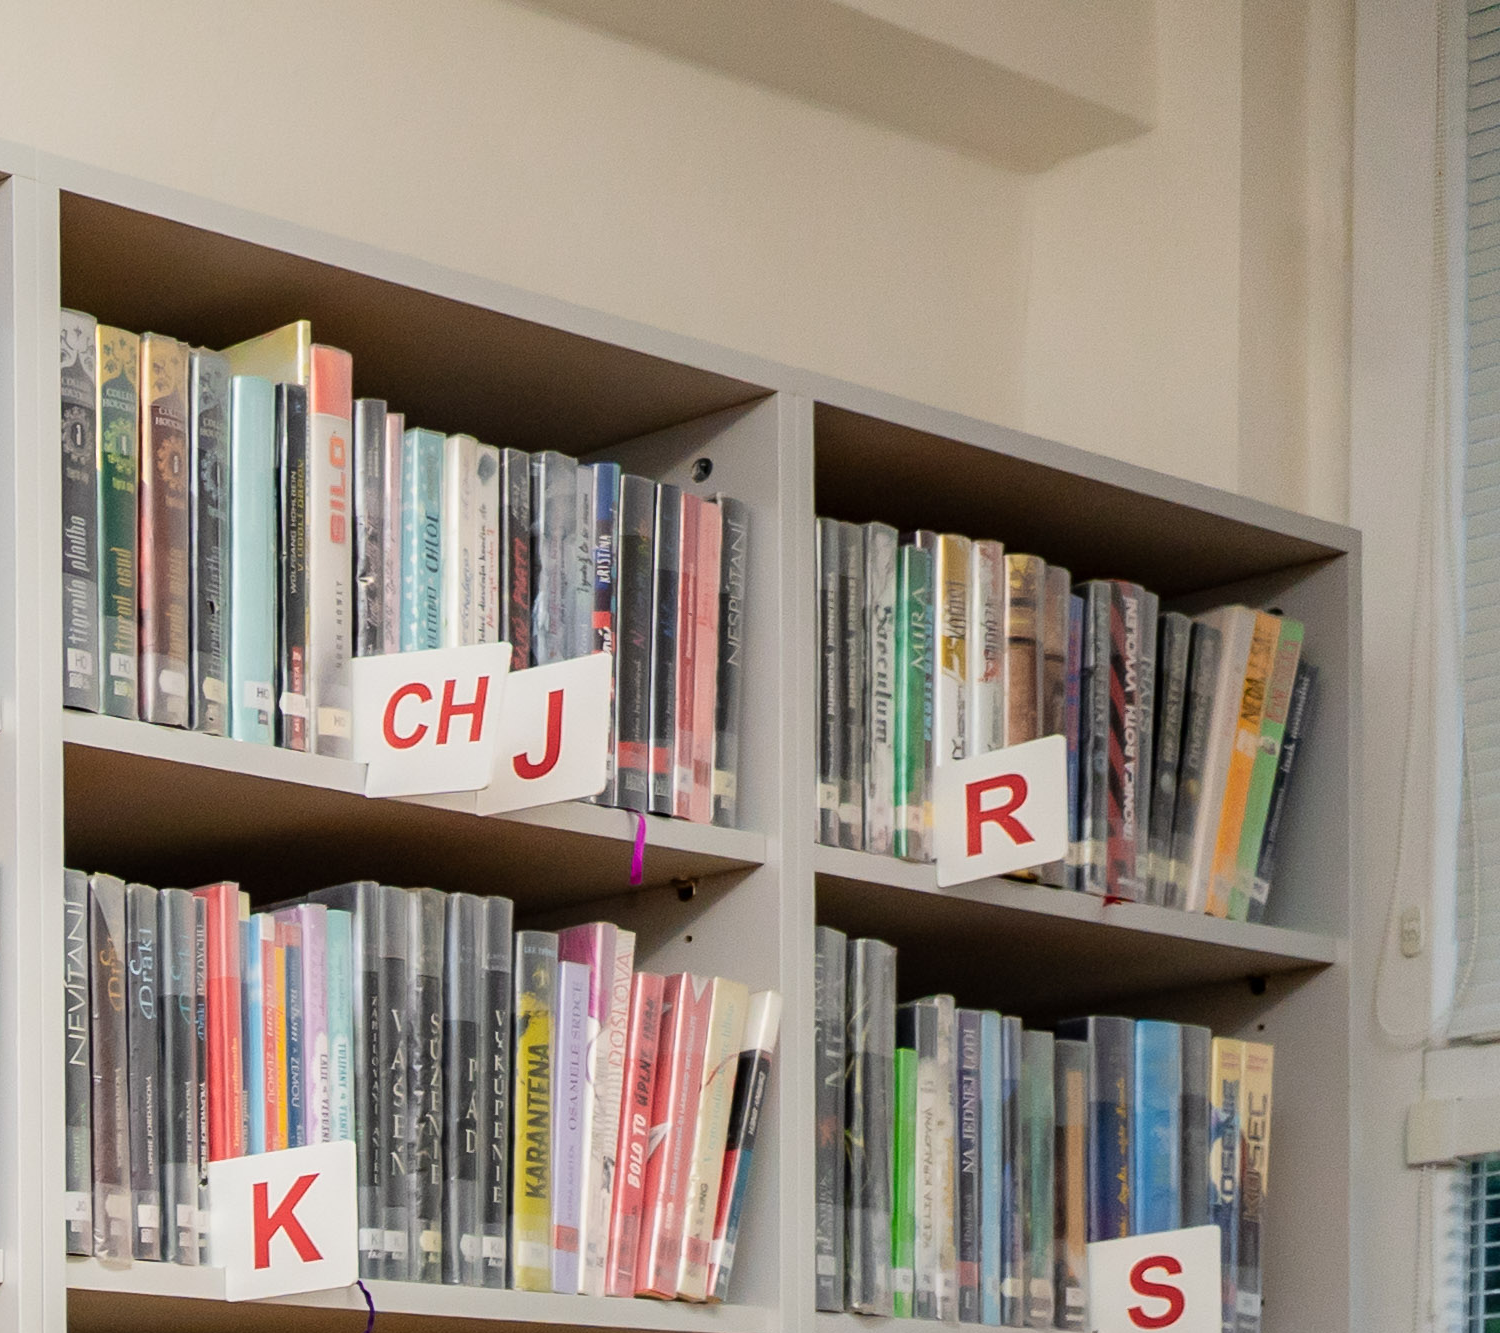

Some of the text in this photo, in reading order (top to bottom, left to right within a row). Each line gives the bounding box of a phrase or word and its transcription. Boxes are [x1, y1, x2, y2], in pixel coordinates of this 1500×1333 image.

[383, 675, 489, 749] CH
[513, 690, 564, 780] J
[965, 772, 1034, 856] R
[252, 1174, 324, 1270] K
[1129, 1255, 1186, 1329] S
